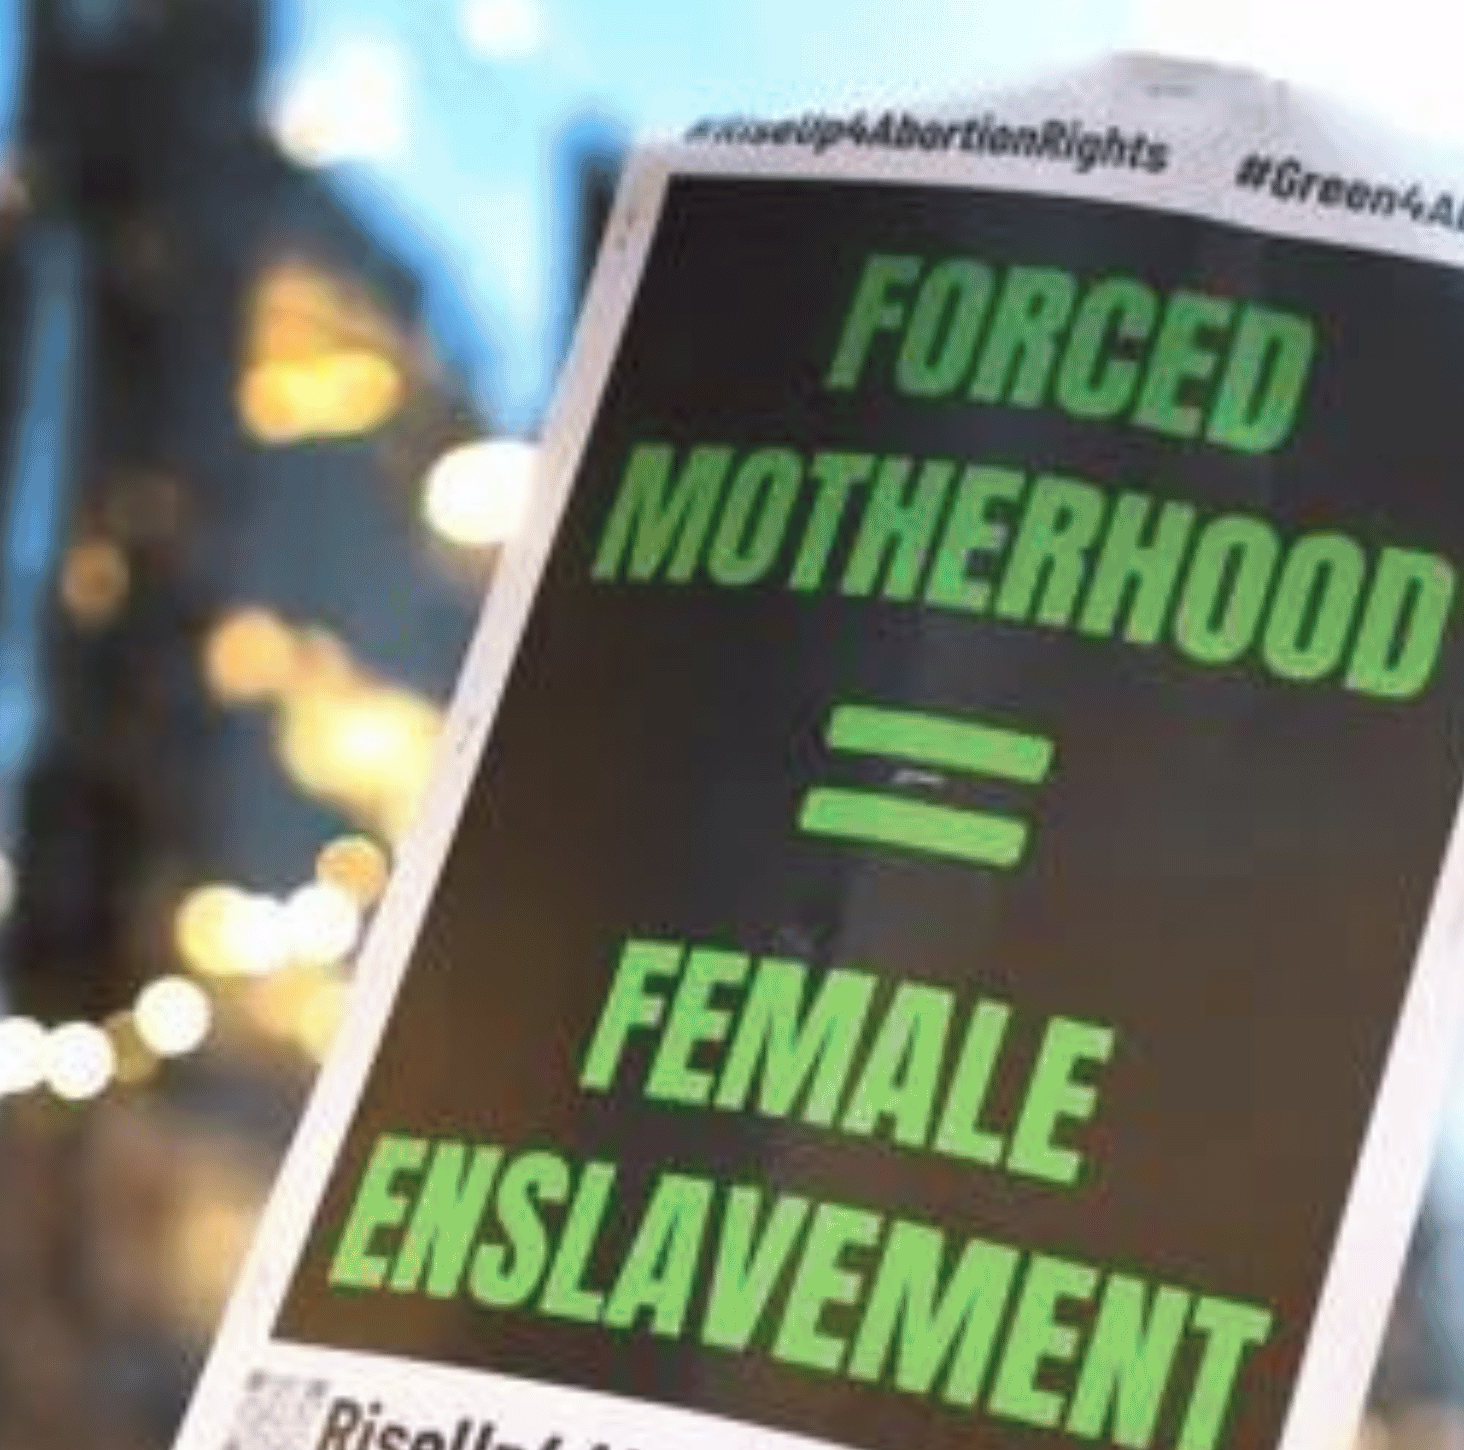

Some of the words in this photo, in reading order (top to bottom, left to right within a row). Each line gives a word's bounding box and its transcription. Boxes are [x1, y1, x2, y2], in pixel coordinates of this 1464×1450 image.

[825, 252, 1318, 455] FORCED
[589, 442, 1459, 701] MOTHERHOOD
[798, 704, 1054, 867] =
[581, 938, 1115, 1184] FEMALE
